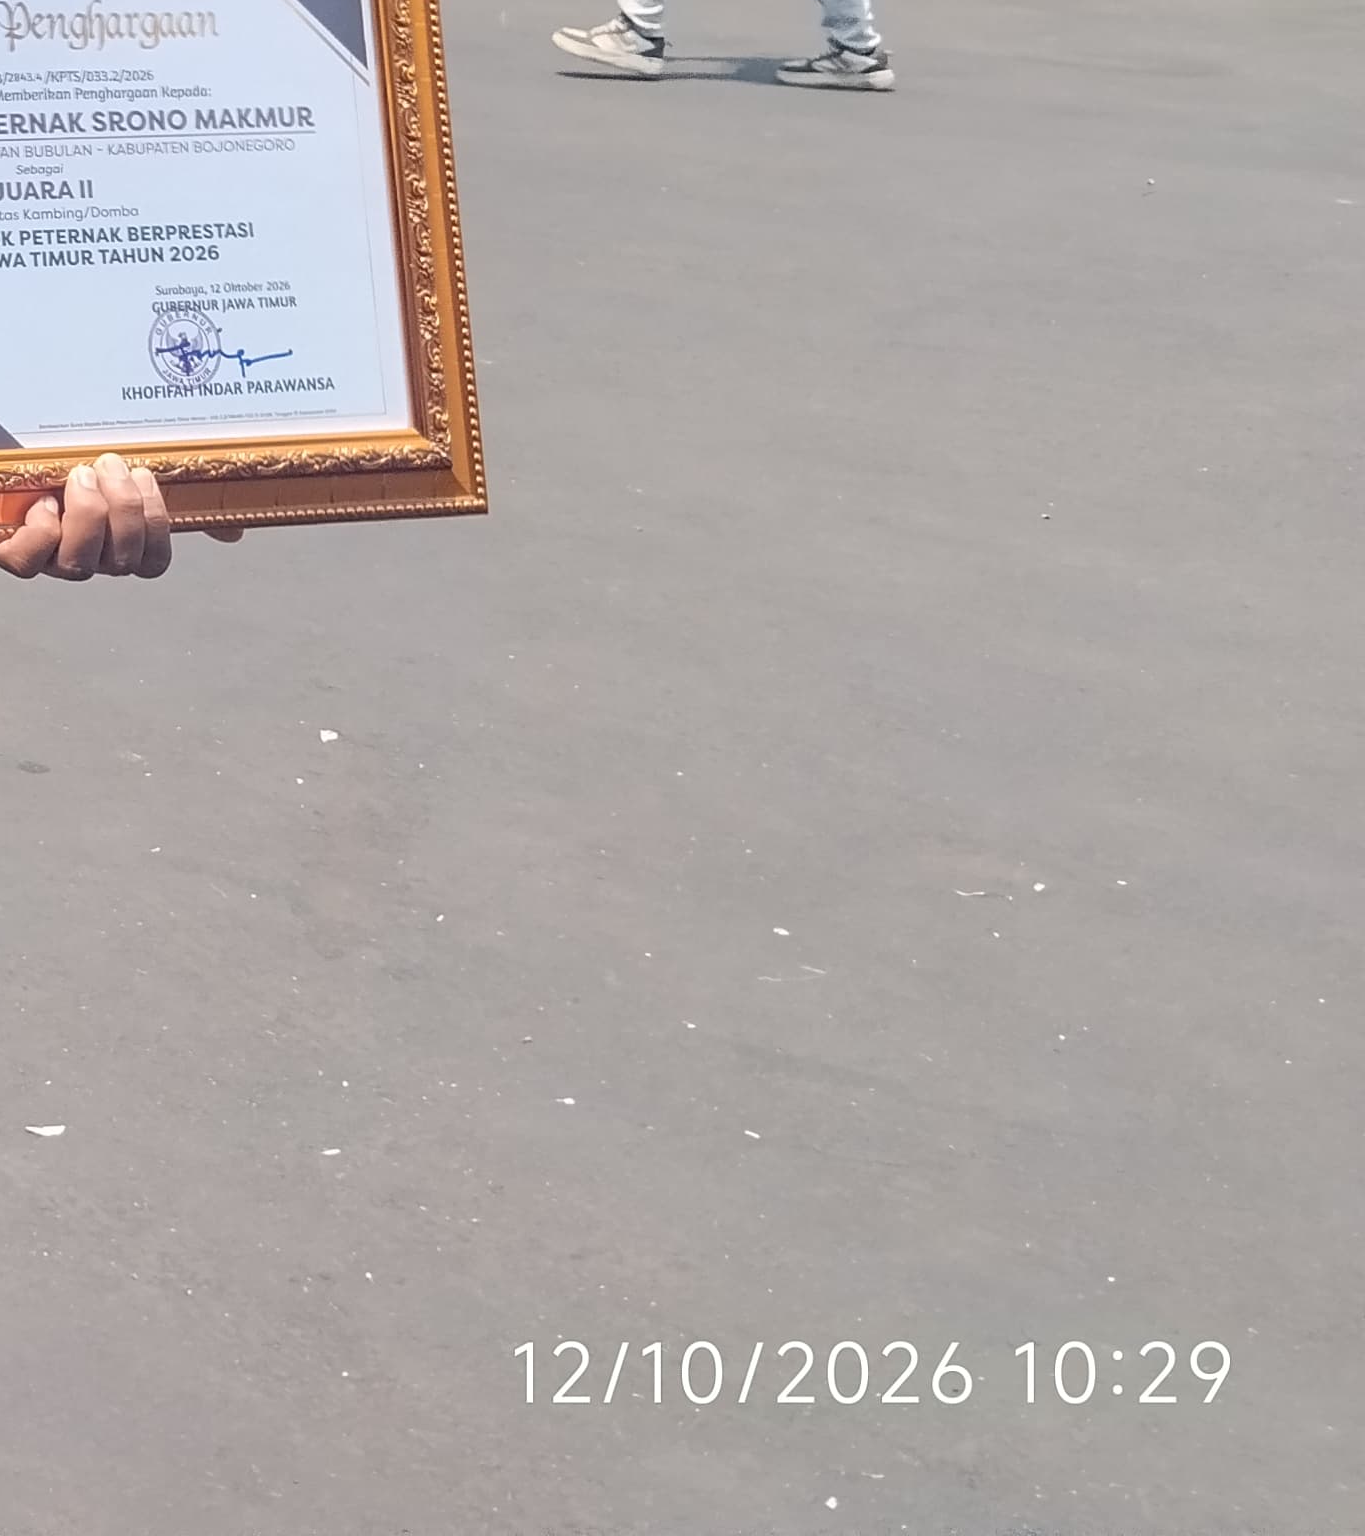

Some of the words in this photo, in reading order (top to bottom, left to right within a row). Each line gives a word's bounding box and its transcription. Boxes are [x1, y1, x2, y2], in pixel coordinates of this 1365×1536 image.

[75, 86, 158, 102] Penghargaan
[161, 85, 212, 100] Kepada:
[92, 109, 188, 133] SRONO
[194, 105, 316, 130] MAKMUR
[24, 143, 93, 158] BUBULAN
[107, 140, 190, 156] KABUPATEN
[193, 138, 297, 154] BOJONEGORO
[15, 163, 65, 177] Sebagai
[79, 179, 95, 200] II
[22, 205, 140, 222] Kambing/Domba
[18, 226, 123, 247] PETERNAK
[126, 221, 255, 243] BERPRESTASI
[29, 249, 95, 268] TIMUR
[98, 246, 165, 265] TAHUN
[169, 244, 220, 262] 2026
[155, 284, 208, 298] Surabaya,
[210, 283, 221, 294] 12
[223, 282, 264, 294] Oktober
[266, 280, 291, 292] 2026
[151, 298, 220, 315] GUBERNUR
[221, 297, 256, 313] JAWA
[257, 295, 298, 309] TIMUR
[121, 383, 195, 401] KHOFIFAH
[198, 381, 244, 397] INDAR
[246, 376, 336, 394] PARAWANSA
